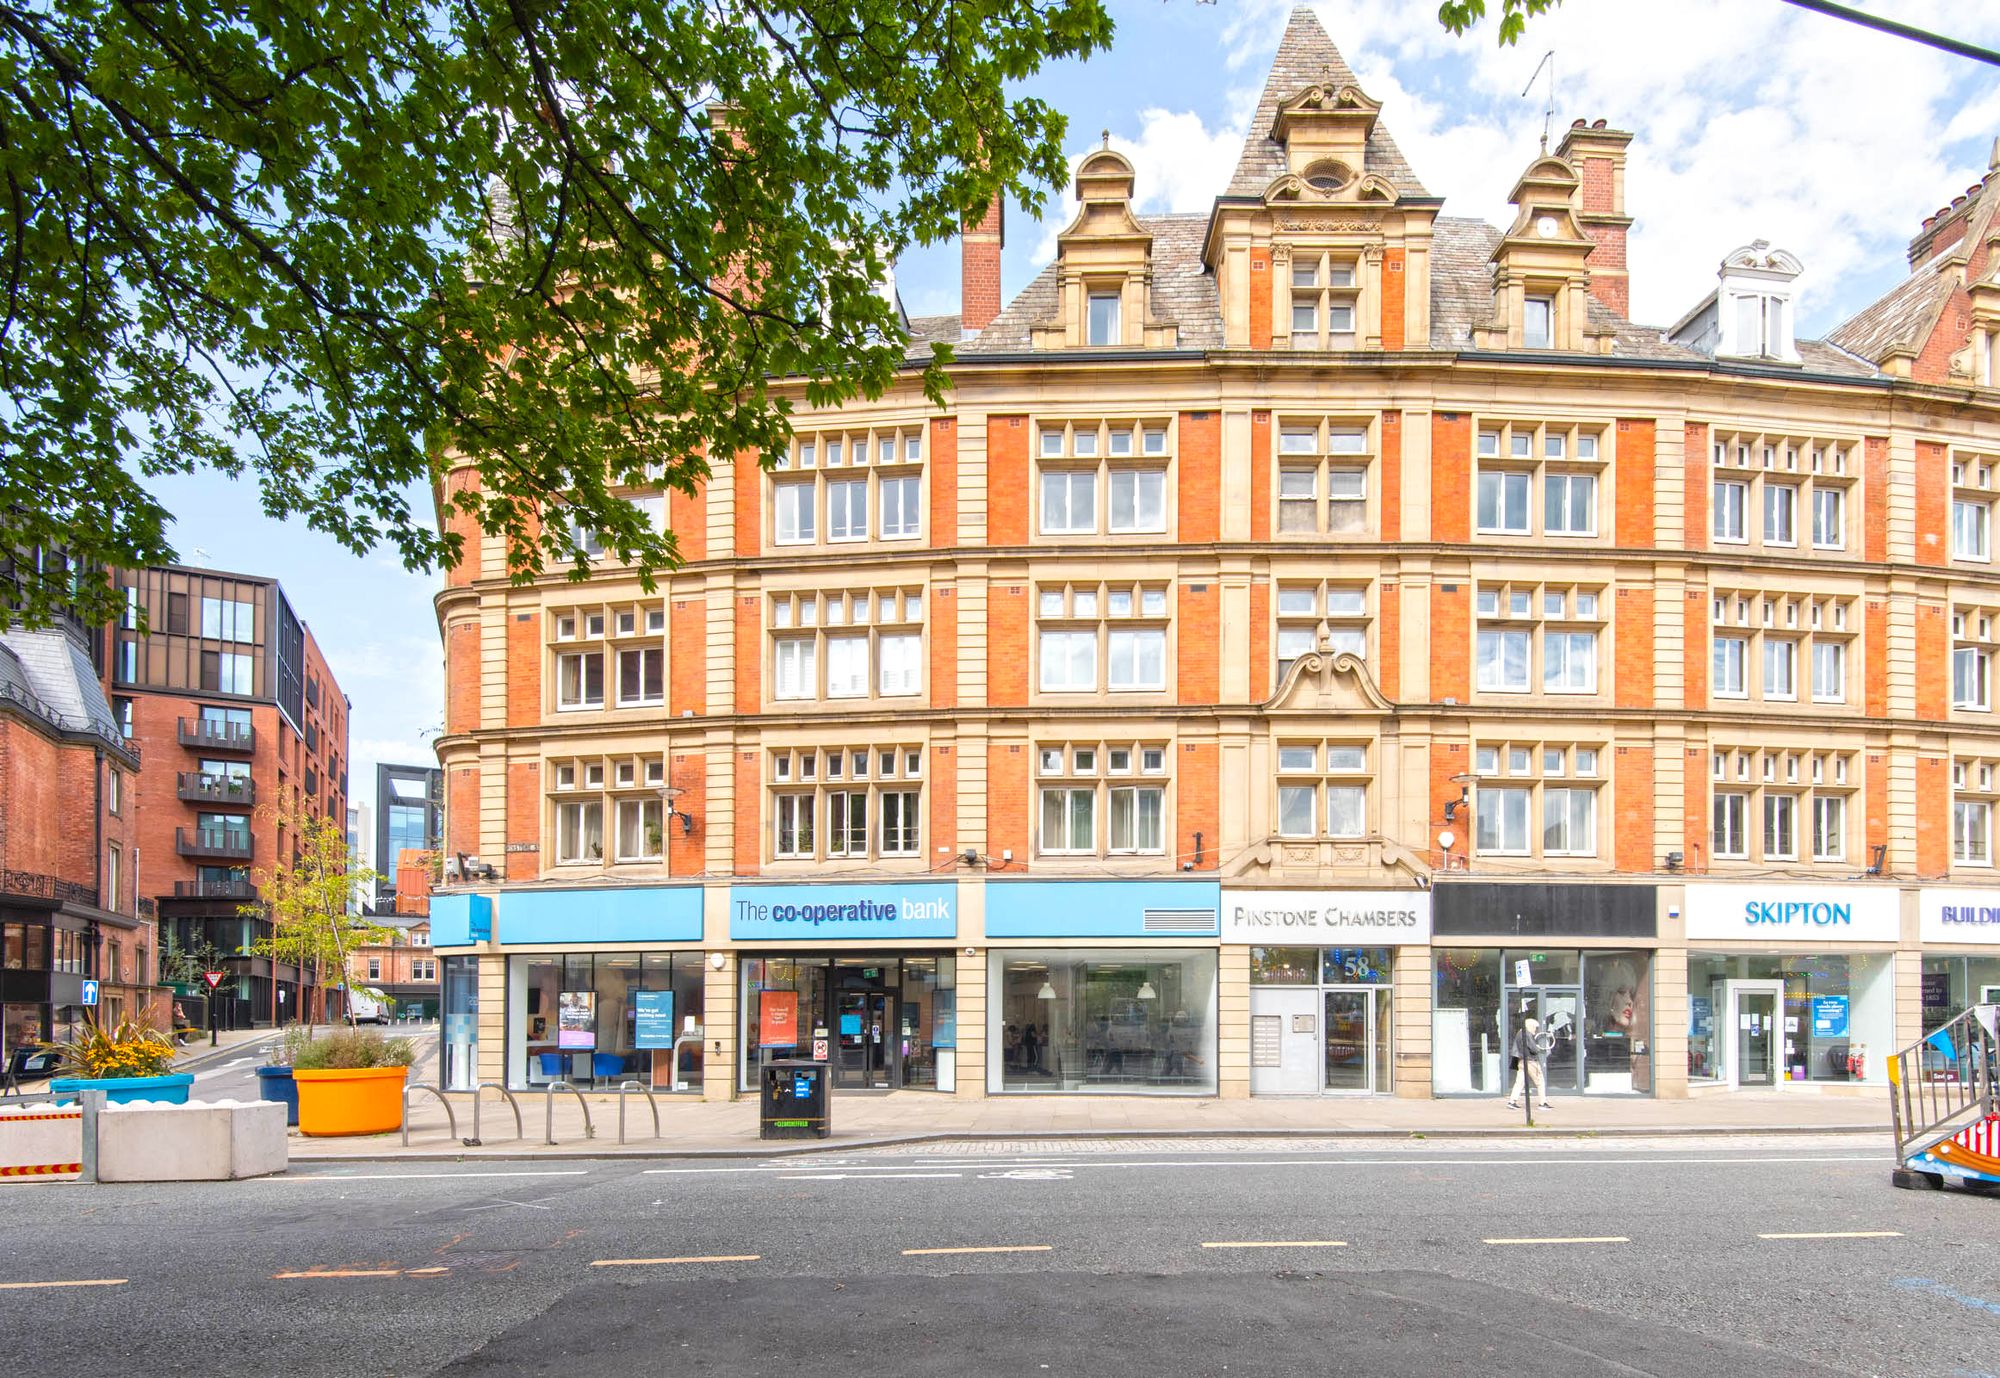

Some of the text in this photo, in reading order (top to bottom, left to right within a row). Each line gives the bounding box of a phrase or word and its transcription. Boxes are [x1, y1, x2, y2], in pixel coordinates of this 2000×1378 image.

[736, 897, 950, 926] The co-operative bank
[1234, 906, 1417, 927] PINSTONE CHAMBERS
[1744, 901, 1851, 924] SKIPTON
[1344, 956, 1370, 977] 58
